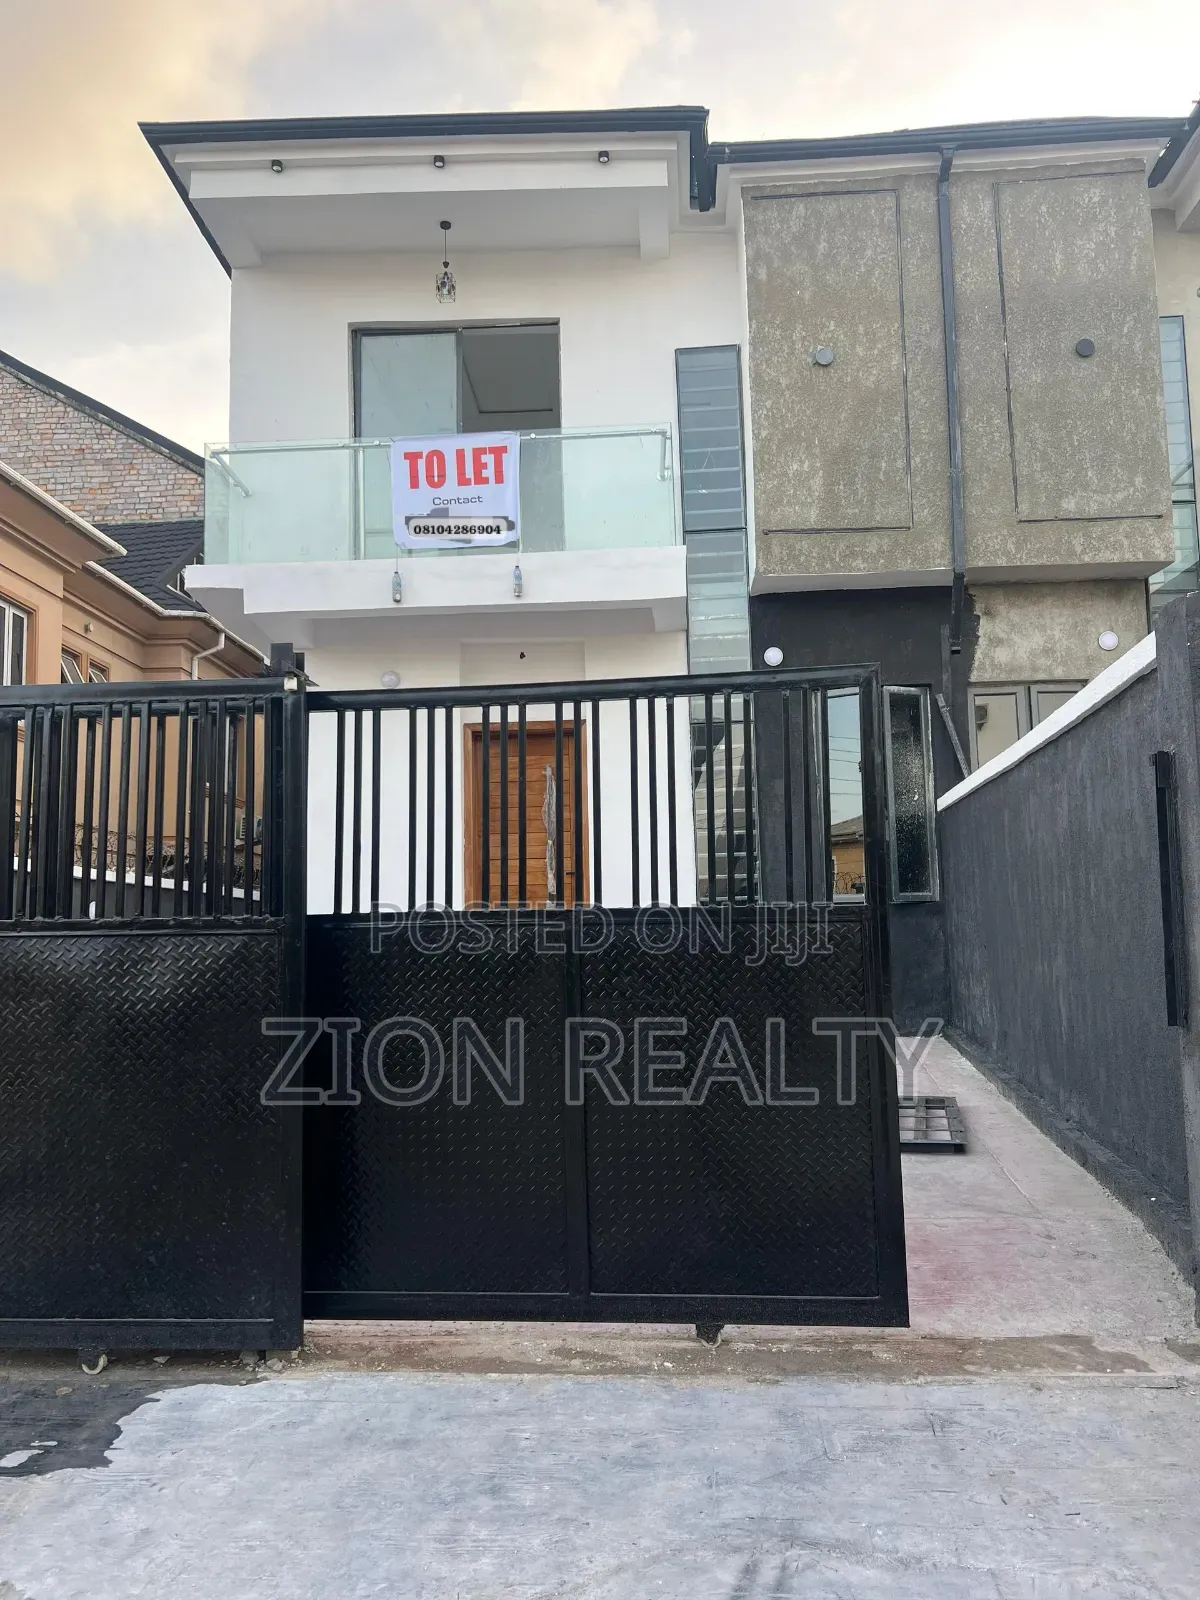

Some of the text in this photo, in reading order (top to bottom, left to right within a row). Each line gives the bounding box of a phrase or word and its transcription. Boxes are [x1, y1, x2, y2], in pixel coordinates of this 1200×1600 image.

[404, 446, 508, 489] TO LET
[432, 495, 483, 506] Contact
